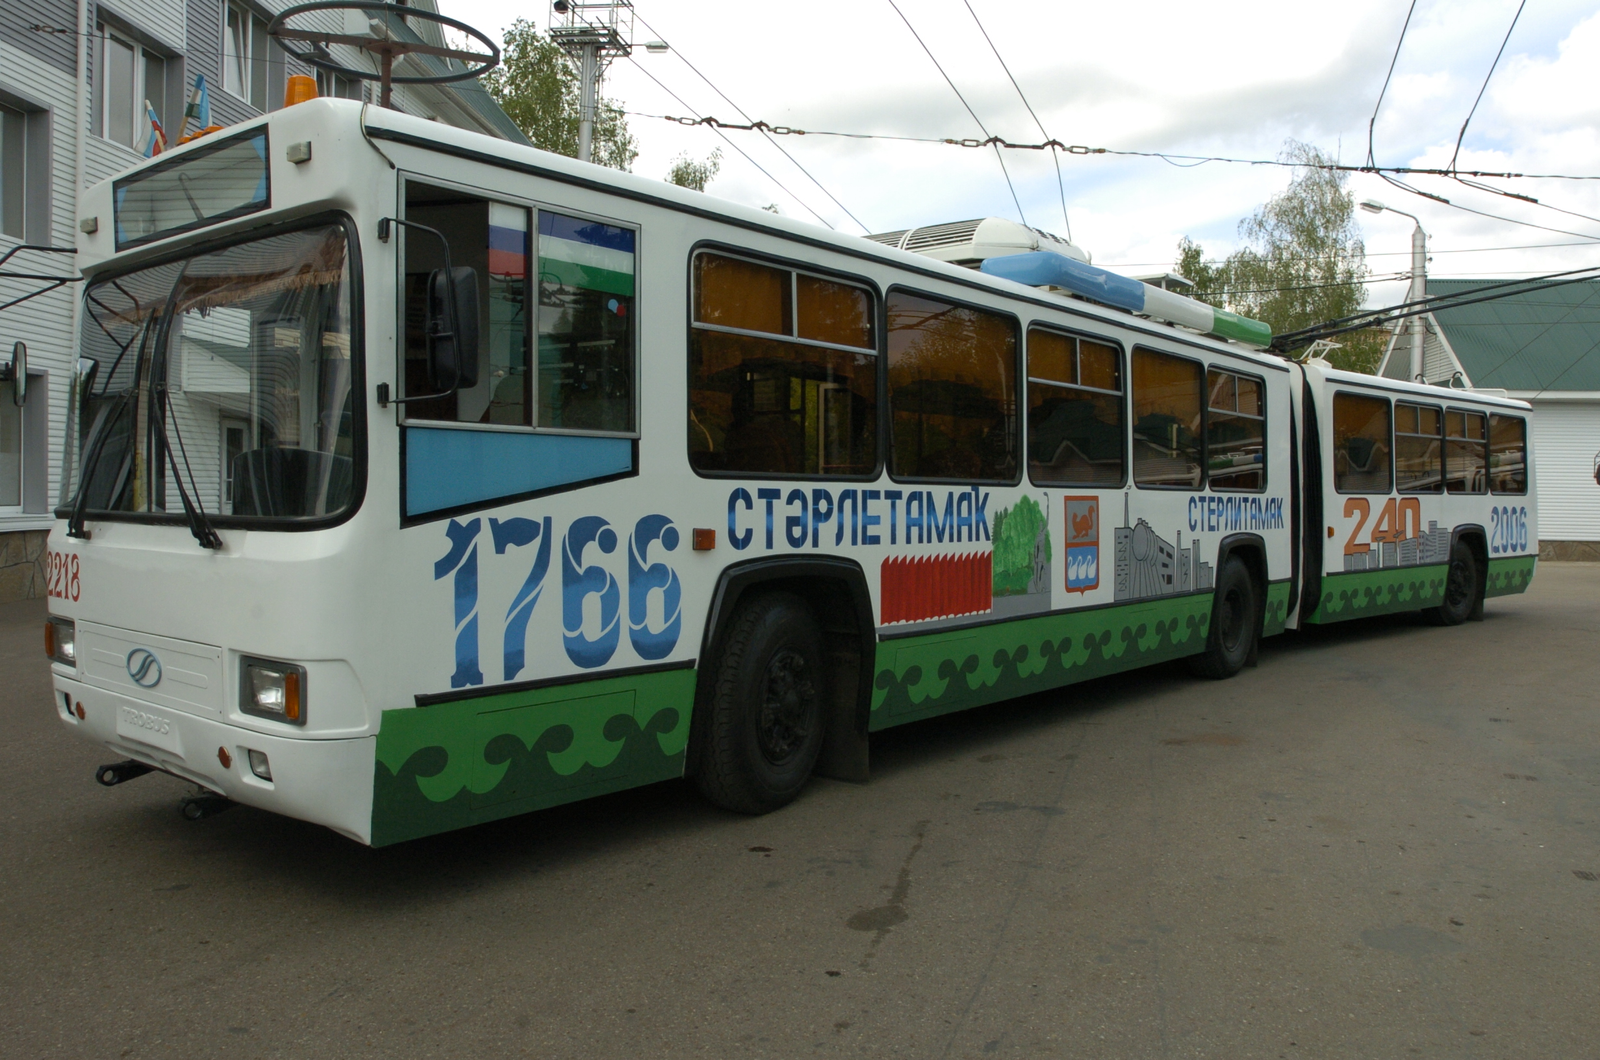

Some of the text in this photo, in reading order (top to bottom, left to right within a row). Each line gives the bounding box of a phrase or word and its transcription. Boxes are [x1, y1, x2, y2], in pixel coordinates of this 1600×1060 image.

[1188, 495, 1284, 532] СТЕРЛИТАМАК
[1343, 497, 1420, 555] 240
[1490, 506, 1528, 554] 2006
[47, 550, 81, 602] 2218
[434, 513, 682, 688] 1766
